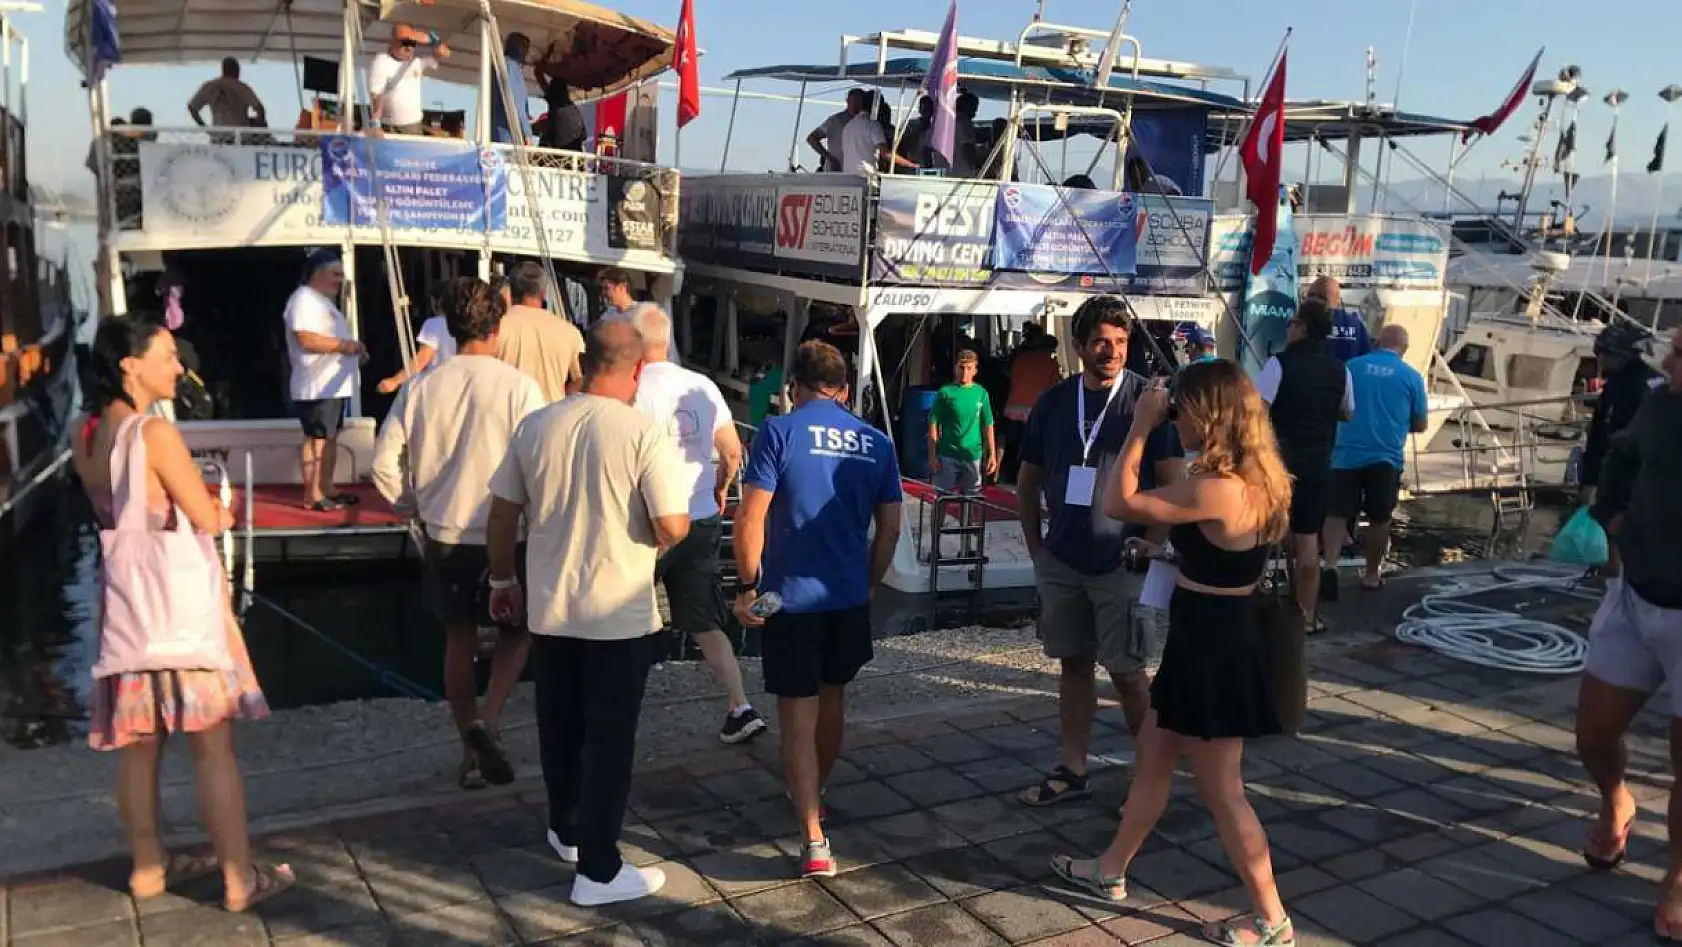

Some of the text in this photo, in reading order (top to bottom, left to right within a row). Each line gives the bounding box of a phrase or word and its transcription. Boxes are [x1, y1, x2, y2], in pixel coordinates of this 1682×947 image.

[777, 194, 860, 249] SSI SCUBA
[913, 192, 991, 236] BEST
[1150, 213, 1204, 230] SCUBA
[812, 220, 859, 239] SCHOOLS
[1301, 224, 1374, 256] BEGÜM
[883, 237, 944, 263] DIVING
[874, 292, 931, 306] CALIPSO
[809, 425, 875, 454] TSSF
